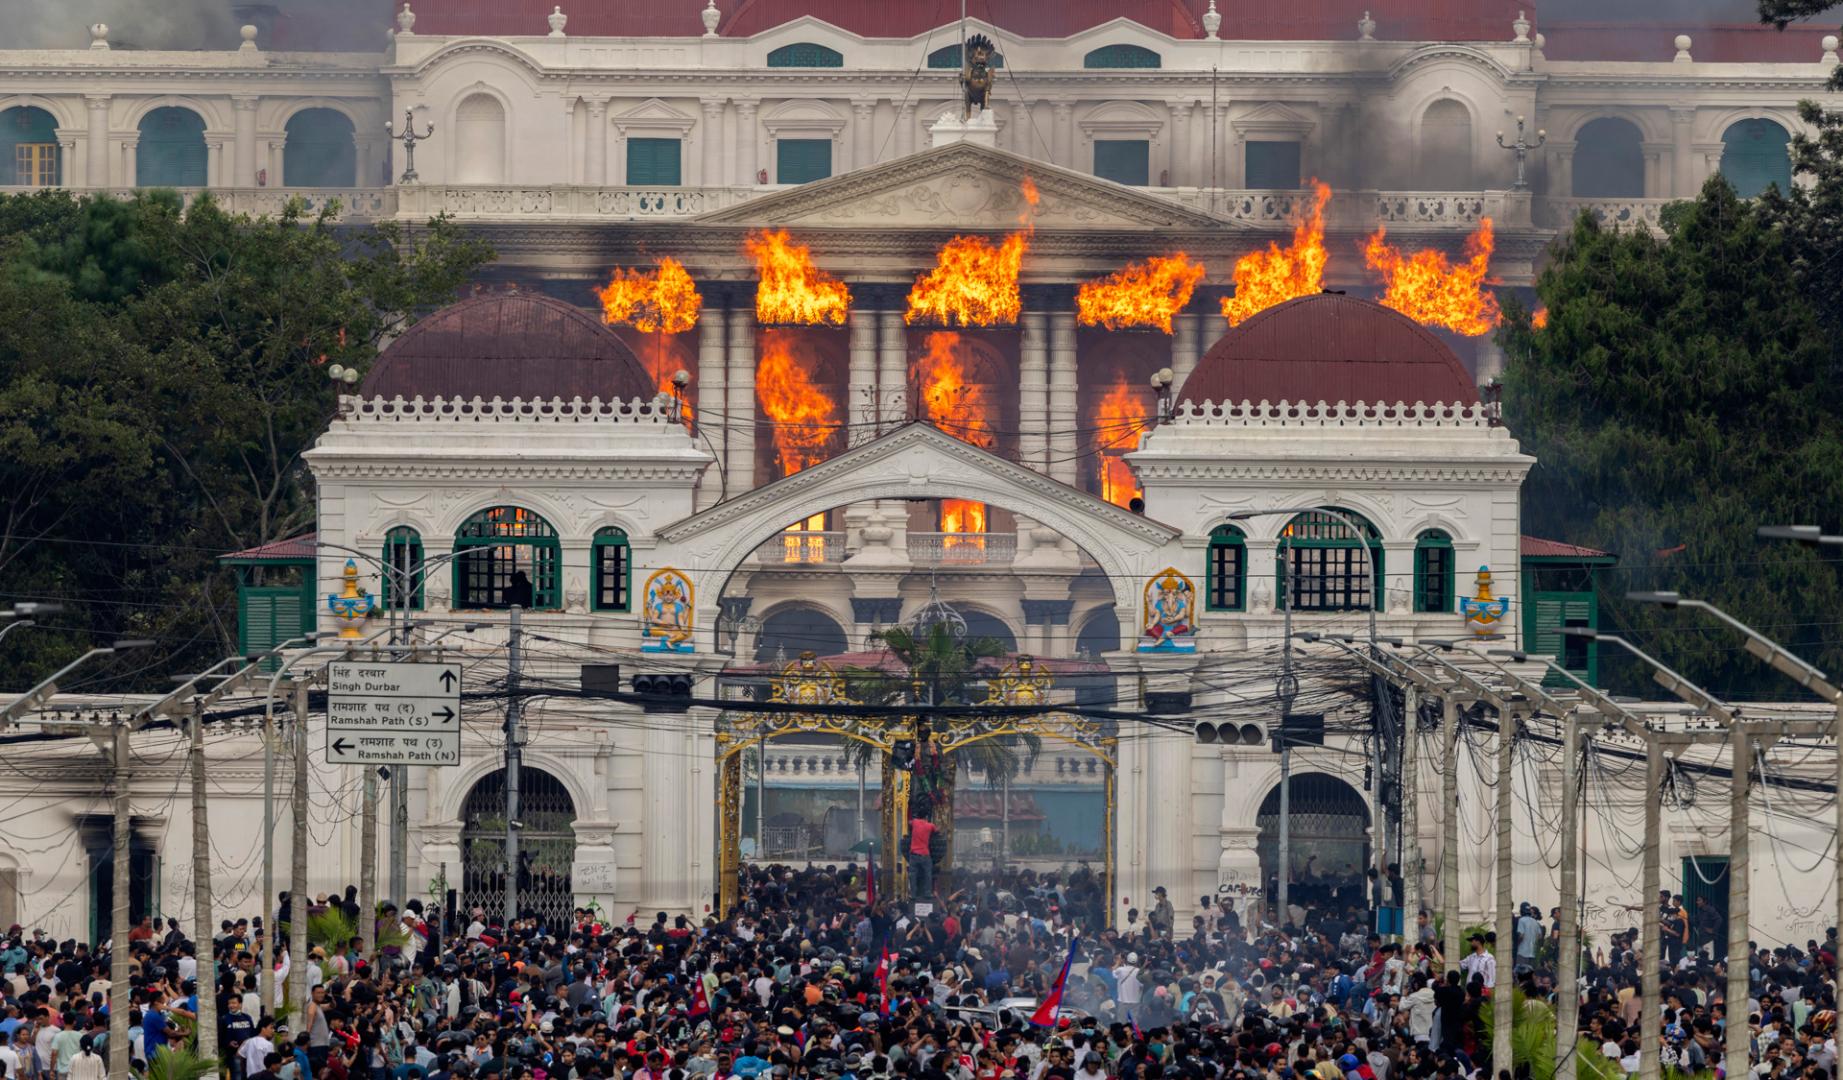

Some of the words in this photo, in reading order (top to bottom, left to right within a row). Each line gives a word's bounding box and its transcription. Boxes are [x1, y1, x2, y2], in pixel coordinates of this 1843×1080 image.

[332, 665, 351, 678] सिंह
[358, 668, 387, 678] दरबार
[332, 682, 361, 692] Singh
[365, 682, 400, 692] Durbar
[332, 702, 367, 712] रामशाह
[374, 703, 390, 712] पथ
[397, 703, 415, 714] (द)
[331, 716, 377, 725] Ramshah
[381, 717, 405, 725] Path
[408, 717, 429, 727] (S)
[359, 737, 395, 746] रामशाह
[402, 738, 418, 747] पथ
[426, 738, 443, 749] (उ)
[358, 750, 404, 759] Ramshah
[408, 751, 431, 760] Path
[435, 751, 456, 761] (N)
